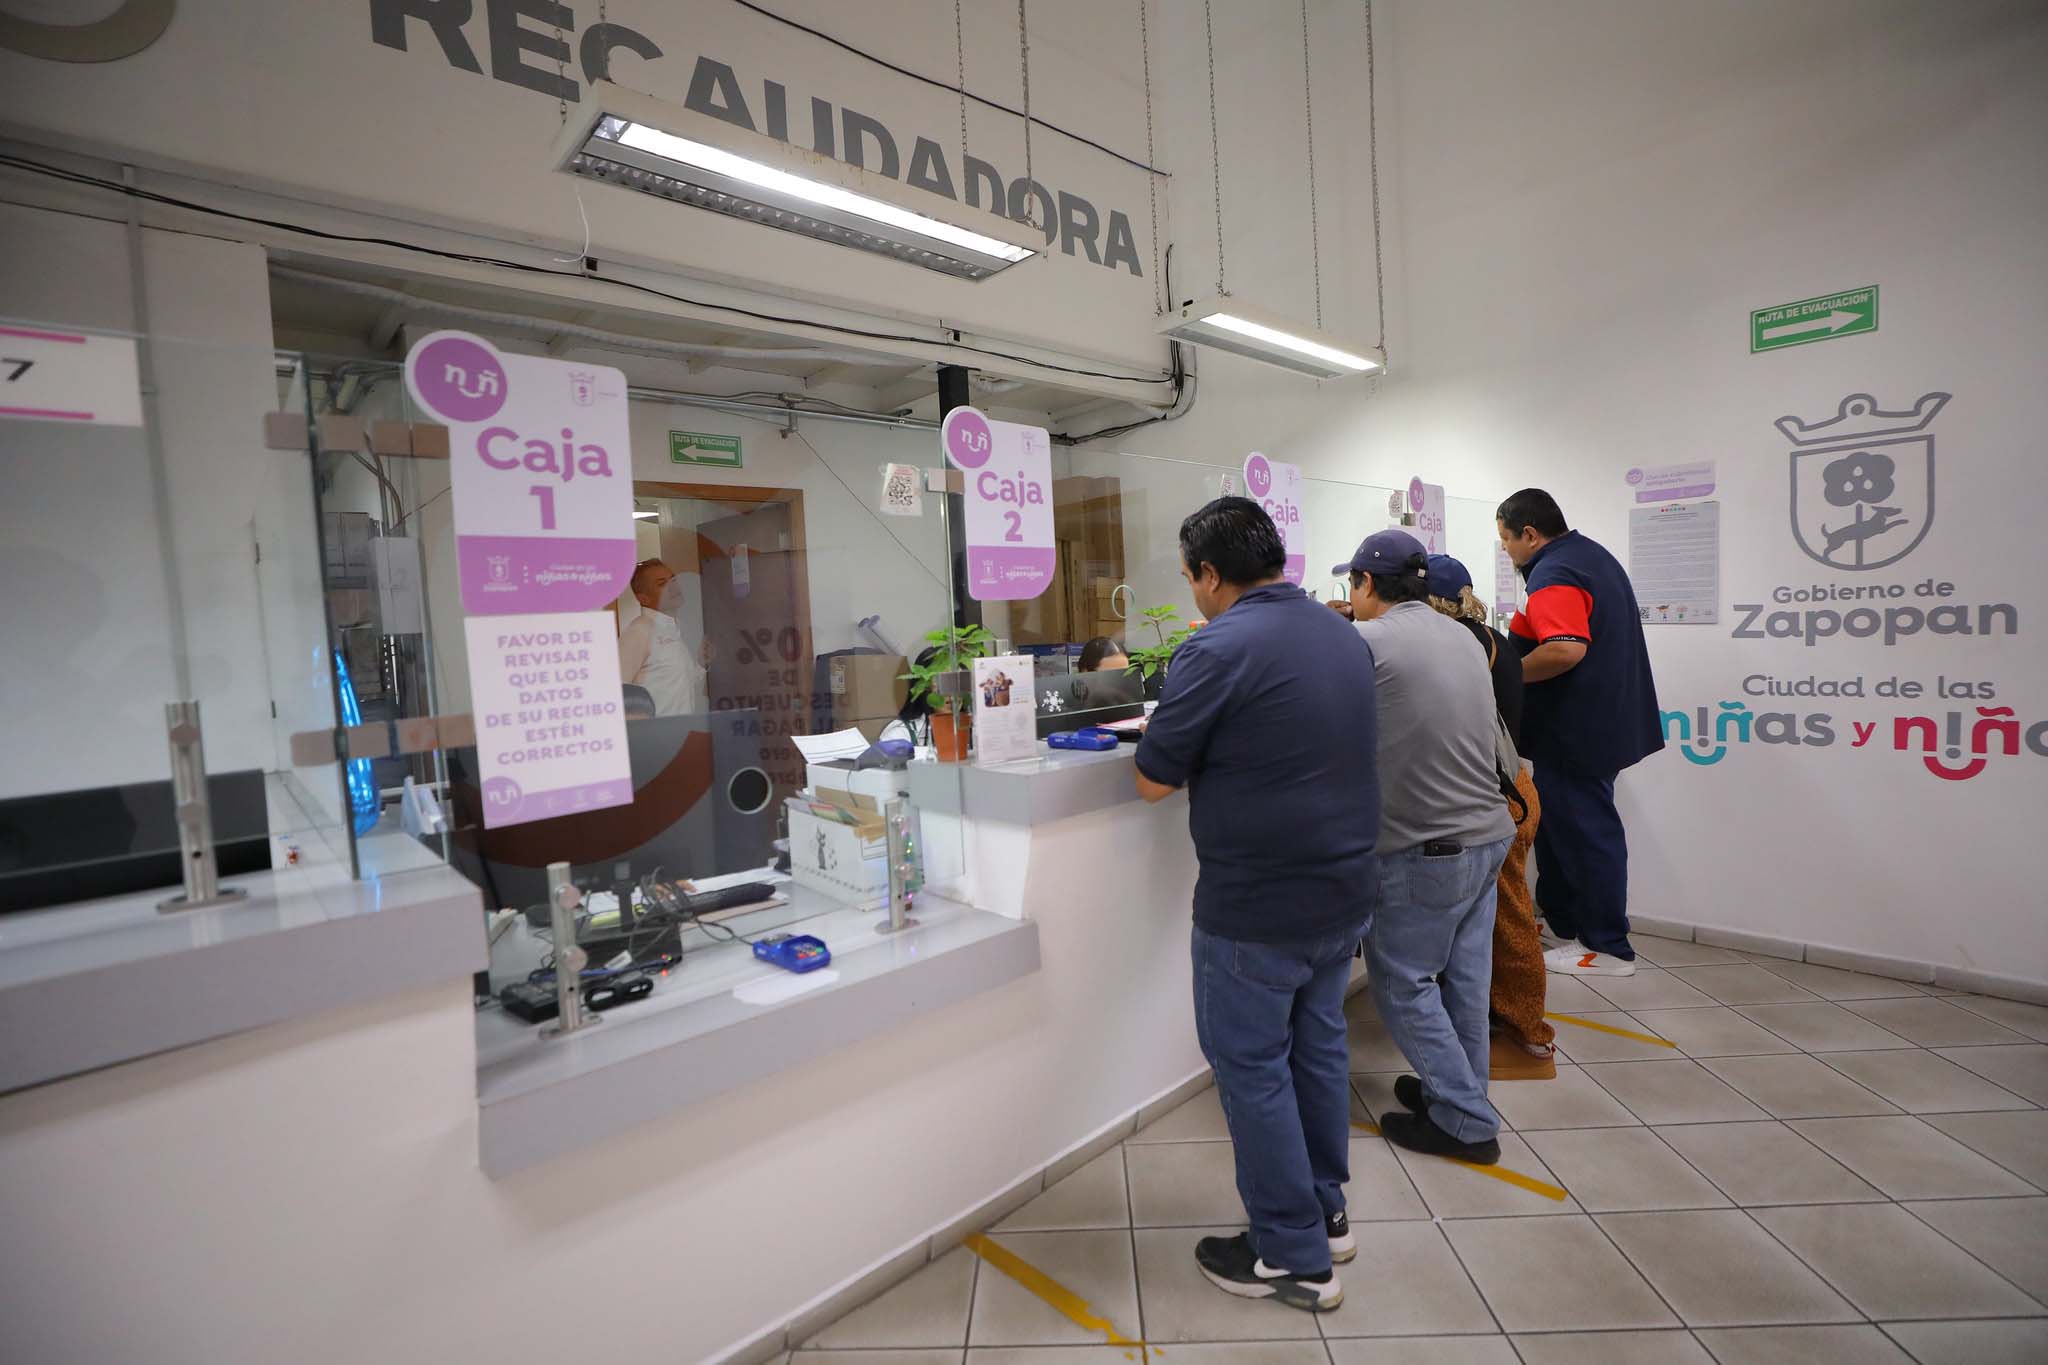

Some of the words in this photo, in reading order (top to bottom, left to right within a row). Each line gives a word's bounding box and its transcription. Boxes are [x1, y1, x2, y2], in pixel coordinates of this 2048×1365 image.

[1759, 311, 1785, 324] RUTA
[1786, 307, 1799, 319] DE
[1, 357, 35, 382] 7
[477, 427, 613, 482] Caja
[977, 471, 1044, 509] Caja
[530, 485, 556, 530] 1
[1263, 497, 1300, 525] Caja
[1004, 511, 1023, 542] 2
[1420, 512, 1442, 534] Caja
[1427, 535, 1435, 553] 4
[1772, 583, 1905, 603] Gobierno
[1914, 579, 1955, 597] de
[1731, 603, 2018, 646] Zapopan
[497, 632, 563, 648] FAVOR
[568, 631, 593, 644] DE
[505, 649, 590, 668] REVISAR
[509, 671, 549, 688] QUE
[555, 668, 589, 683] LOS
[1742, 674, 1865, 698] Ciudad
[1875, 676, 1923, 698] de
[1938, 676, 1996, 699] las
[519, 687, 583, 705] DATOS
[485, 713, 512, 728] DE
[518, 709, 542, 724] SU
[548, 702, 617, 720] RECIBO
[525, 721, 585, 743] ESTÉN
[1851, 722, 1876, 747] y
[497, 738, 614, 765] CORRECTOS
